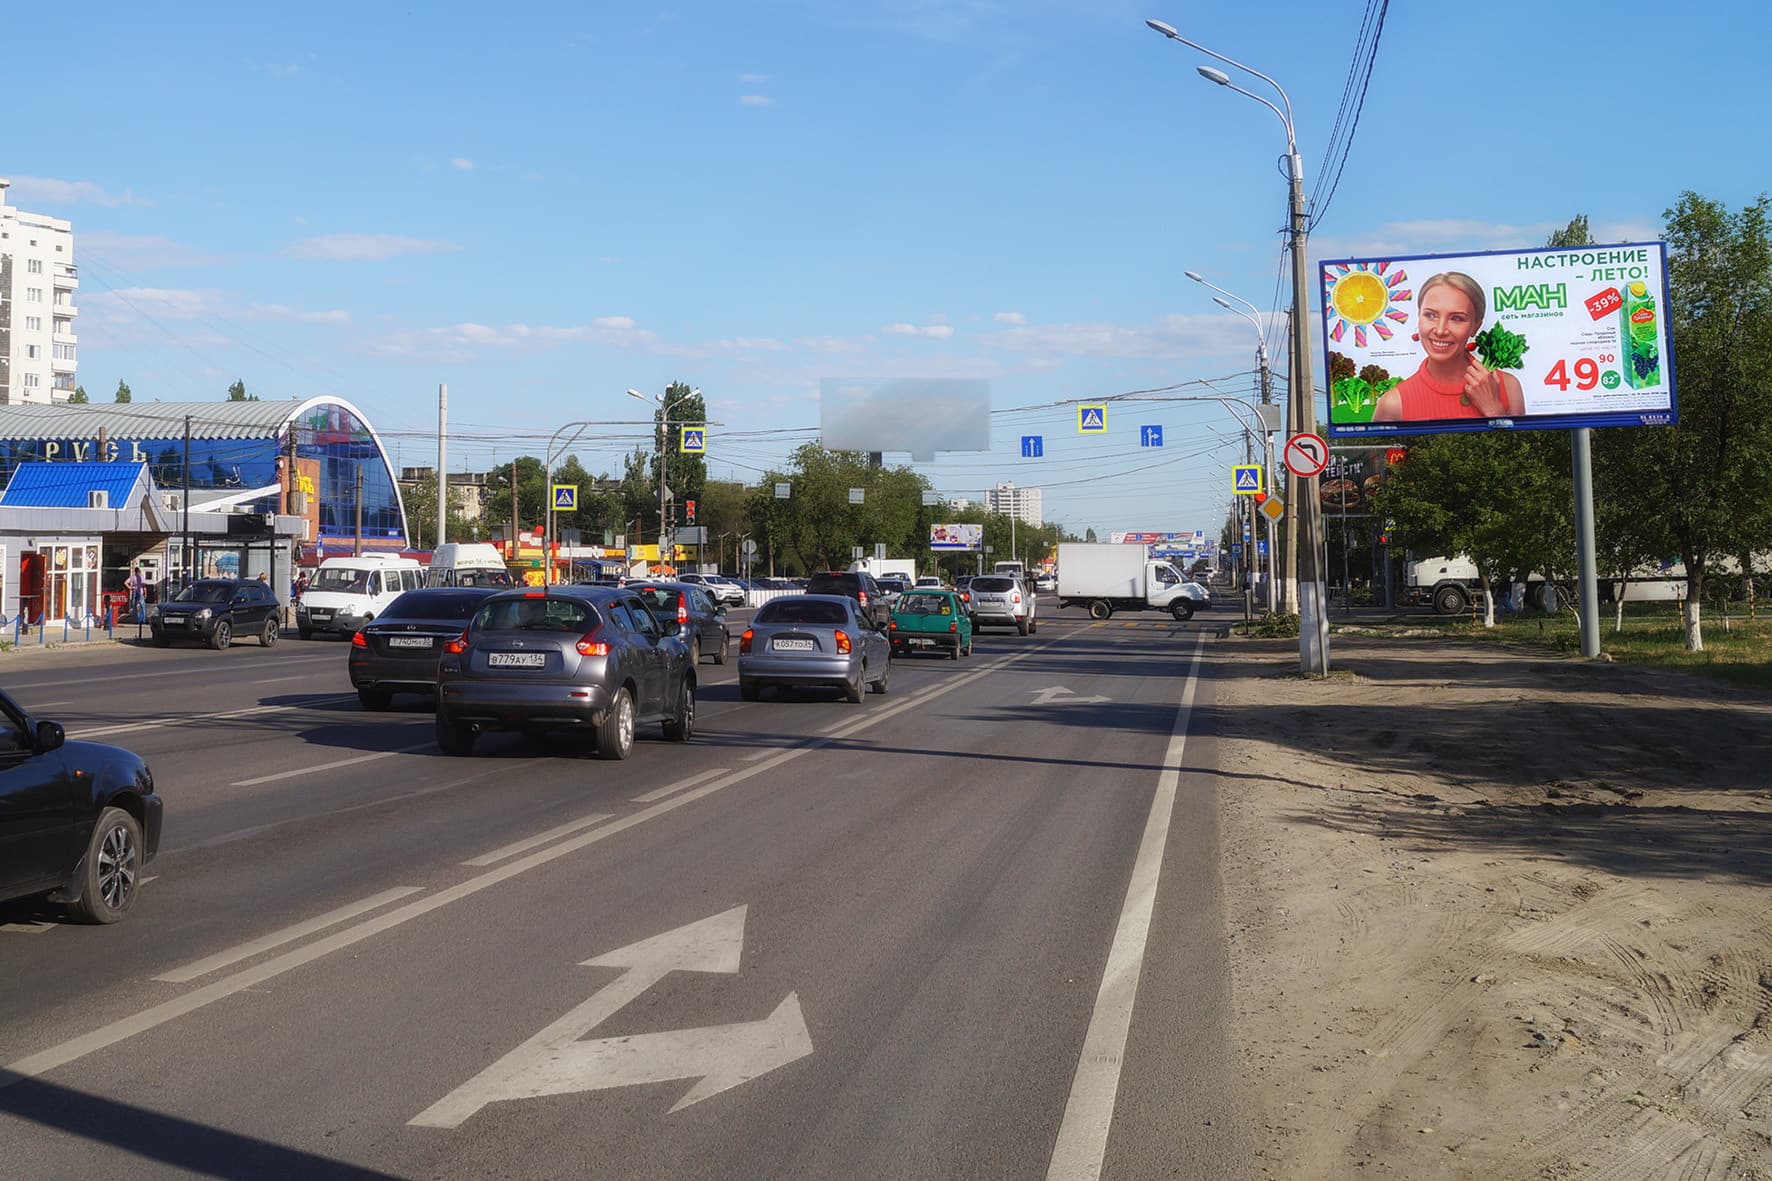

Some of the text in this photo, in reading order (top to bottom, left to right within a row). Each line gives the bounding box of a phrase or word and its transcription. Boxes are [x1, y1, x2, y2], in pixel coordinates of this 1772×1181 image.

[1517, 249, 1648, 270] НАСТРОЕНИЕ
[1590, 266, 1649, 282] ЛЕТО!
[1493, 282, 1568, 312] МАН
[1589, 292, 1619, 313] -39%
[1501, 311, 1564, 321] сеть магазинов
[1543, 353, 1615, 392] 49 90
[45, 441, 147, 463] РУСЬ
[491, 654, 527, 665] В779АУ
